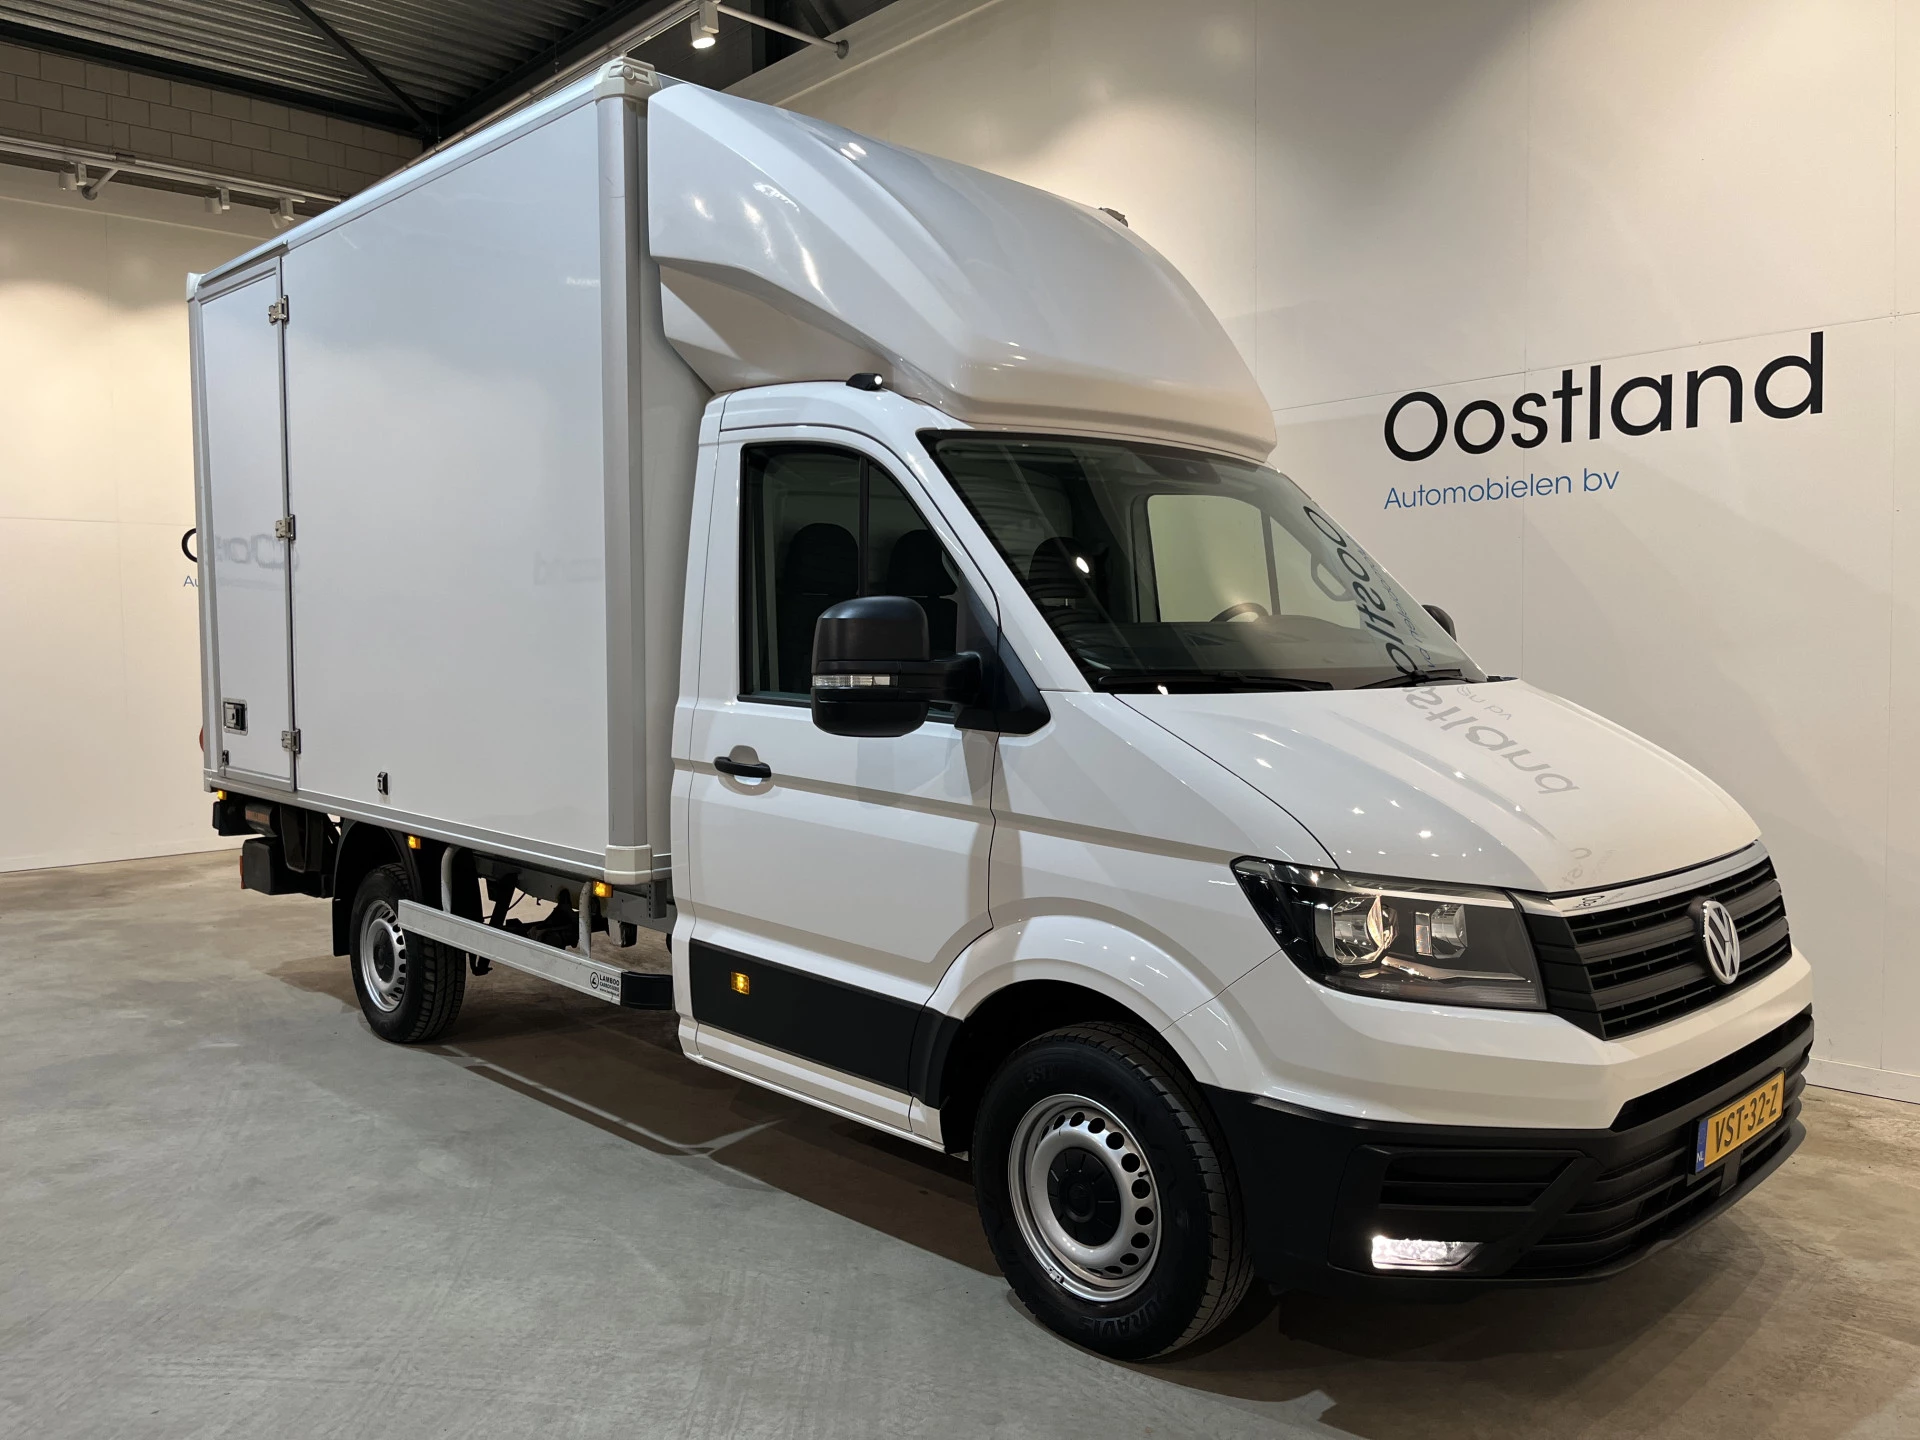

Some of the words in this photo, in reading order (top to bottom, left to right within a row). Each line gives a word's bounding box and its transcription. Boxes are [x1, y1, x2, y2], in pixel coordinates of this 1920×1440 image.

[1384, 331, 1824, 461] Oostland
[1384, 473, 1572, 510] Automobielen
[1583, 467, 1620, 493] bv
[1715, 1082, 1779, 1153] VST-32-Z
